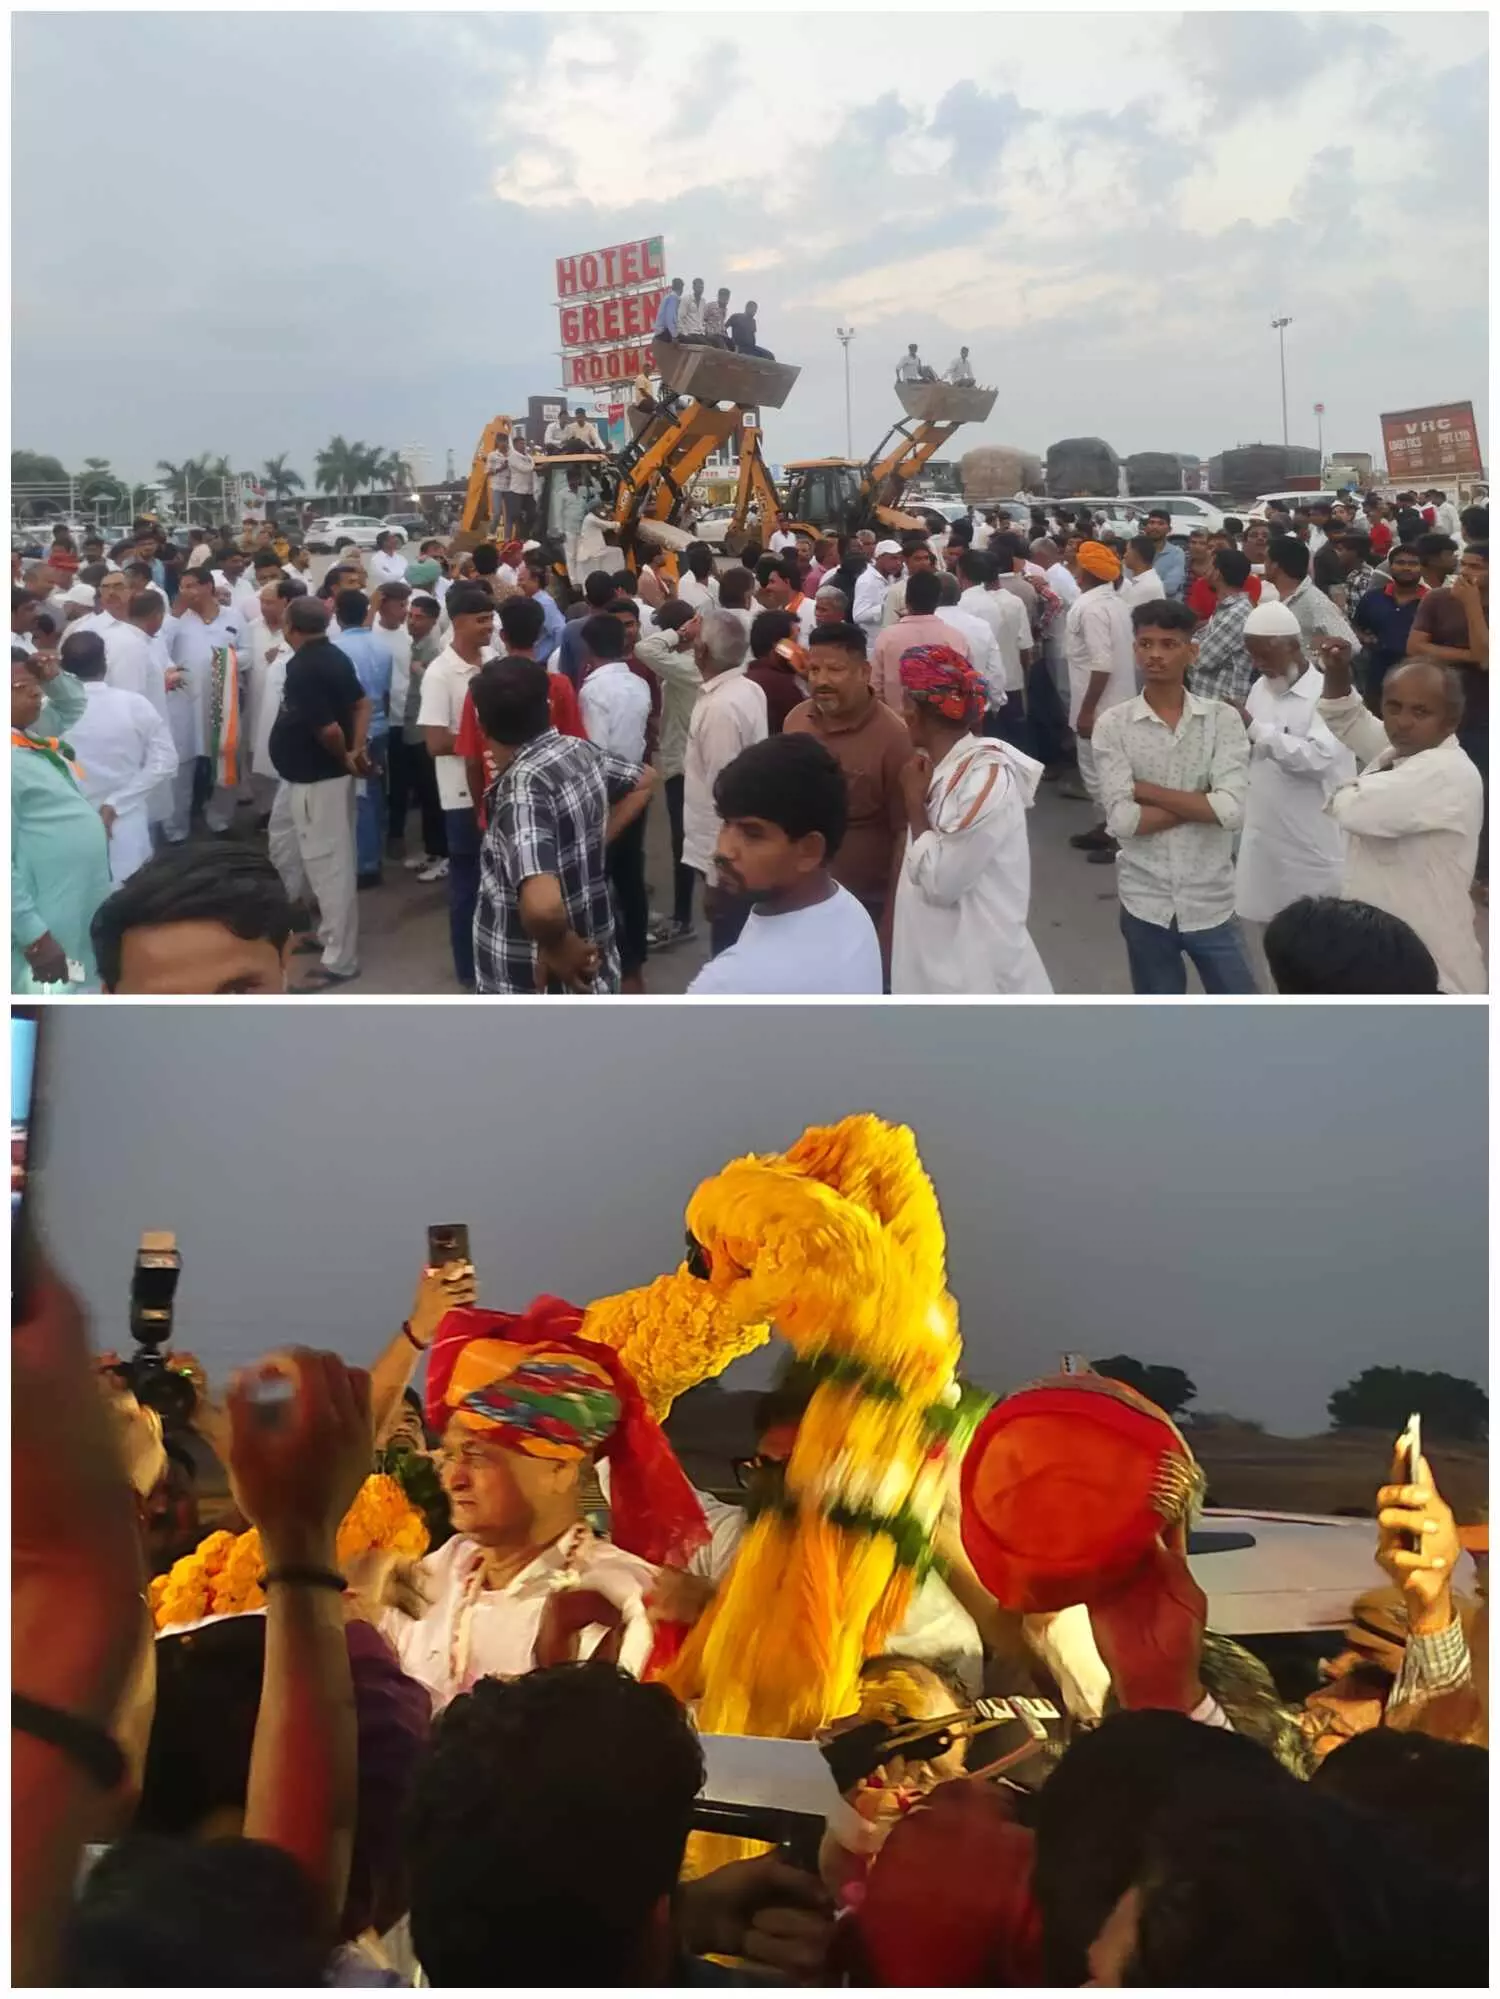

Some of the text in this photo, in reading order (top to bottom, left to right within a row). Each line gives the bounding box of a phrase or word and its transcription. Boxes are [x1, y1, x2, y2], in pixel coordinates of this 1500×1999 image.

[557, 240, 661, 297] HOTEL
[562, 292, 661, 344] GREEN
[573, 347, 657, 385] ROOMS
